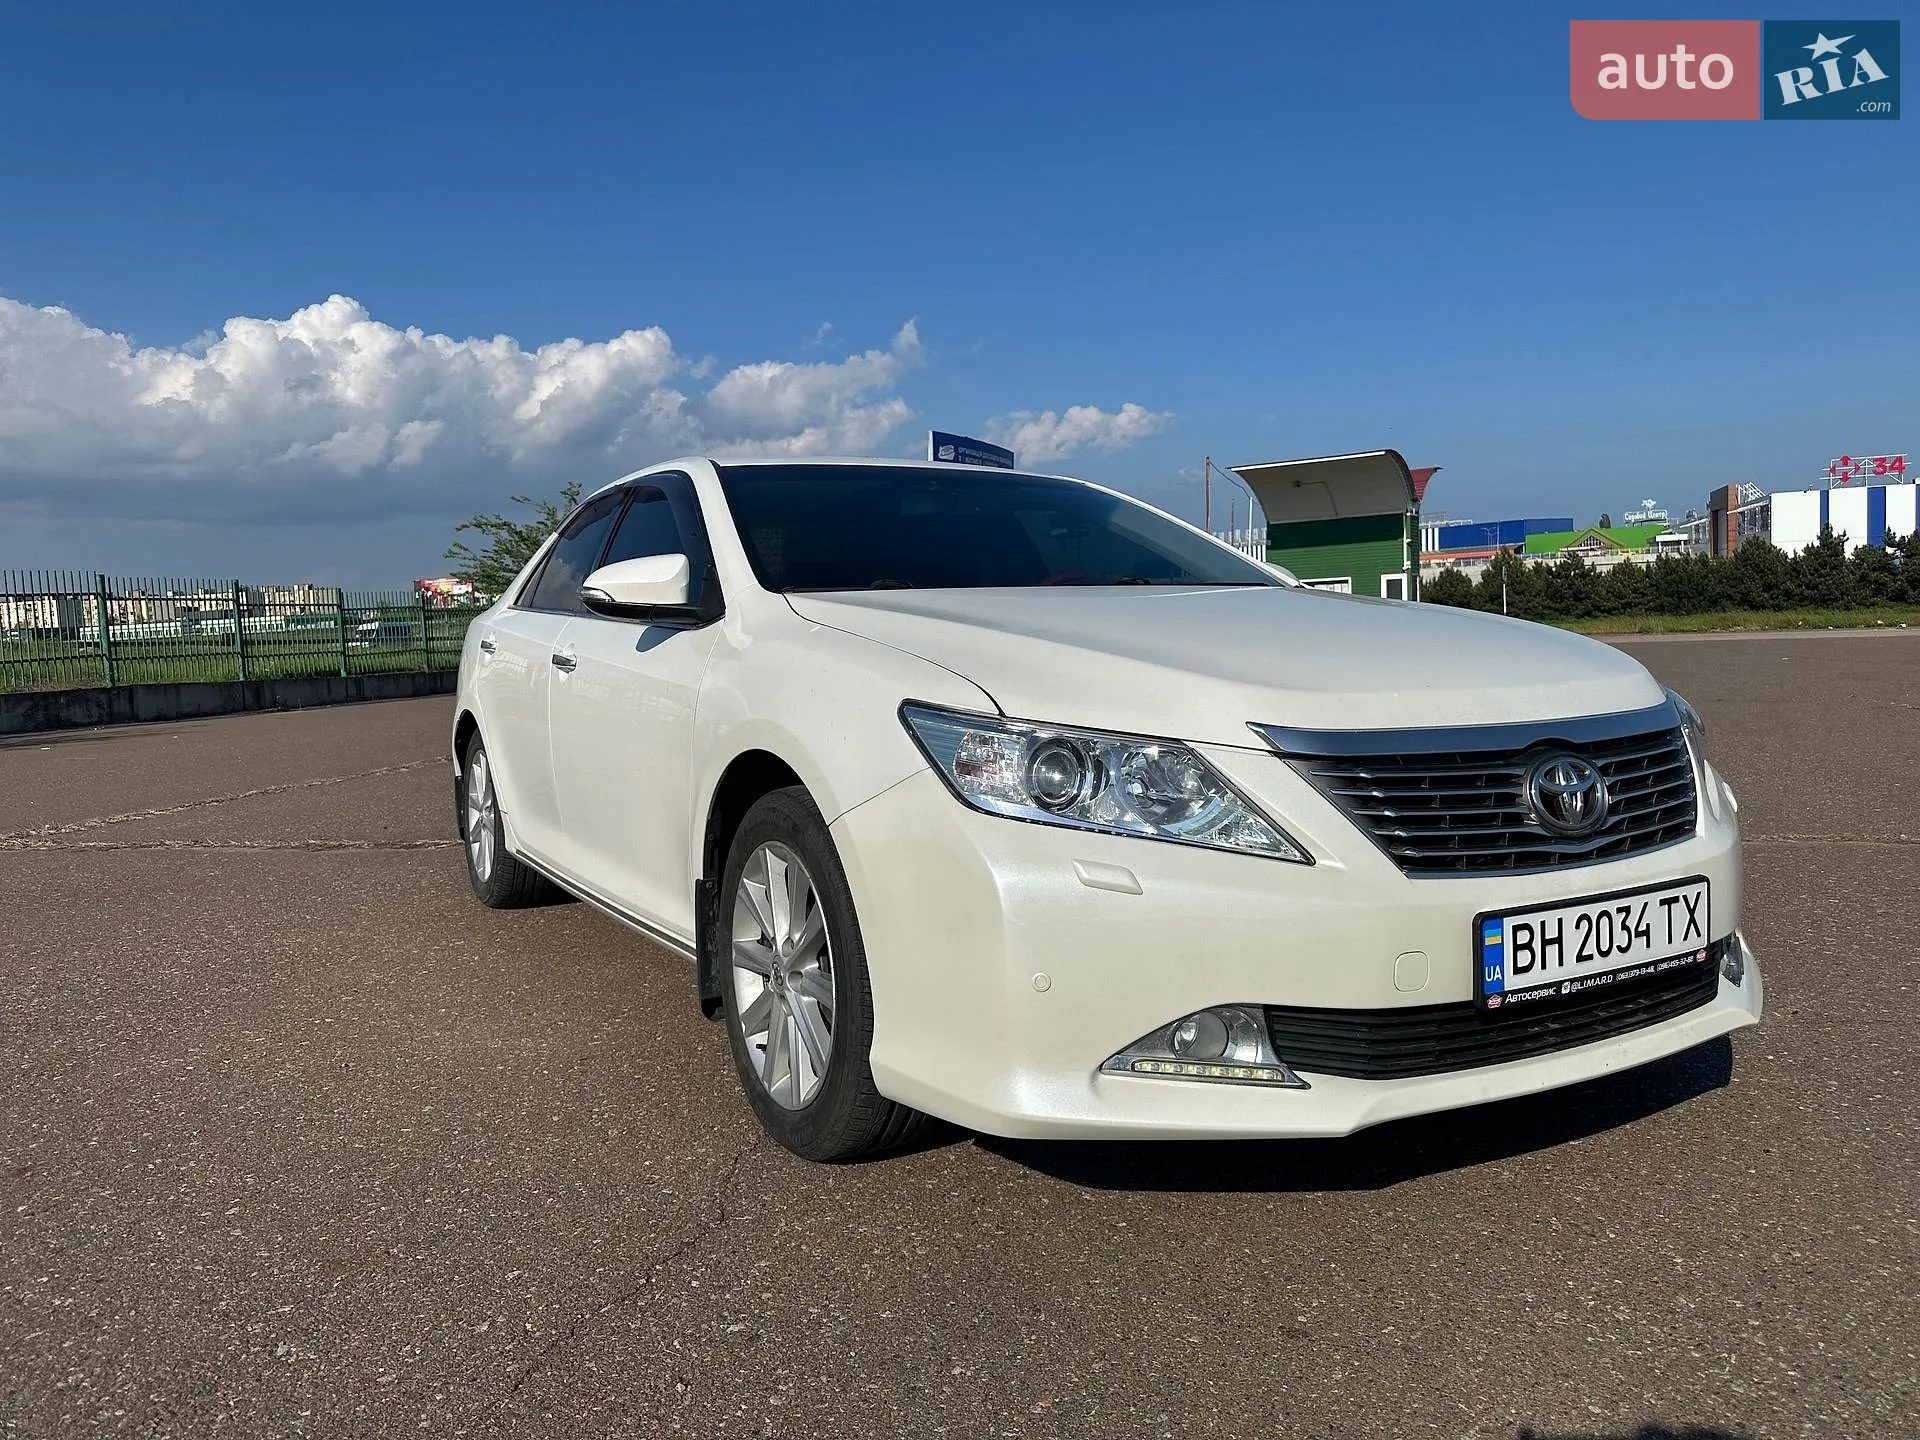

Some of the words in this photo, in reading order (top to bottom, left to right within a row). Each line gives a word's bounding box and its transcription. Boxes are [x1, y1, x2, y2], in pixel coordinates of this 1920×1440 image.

[1872, 455, 1906, 476] 34
[1511, 917, 1564, 976] BH
[1574, 901, 1652, 964] 2034
[1659, 890, 1702, 945] TX
[1485, 965, 1502, 982] UA
[1504, 986, 1557, 1004] Автосервис
